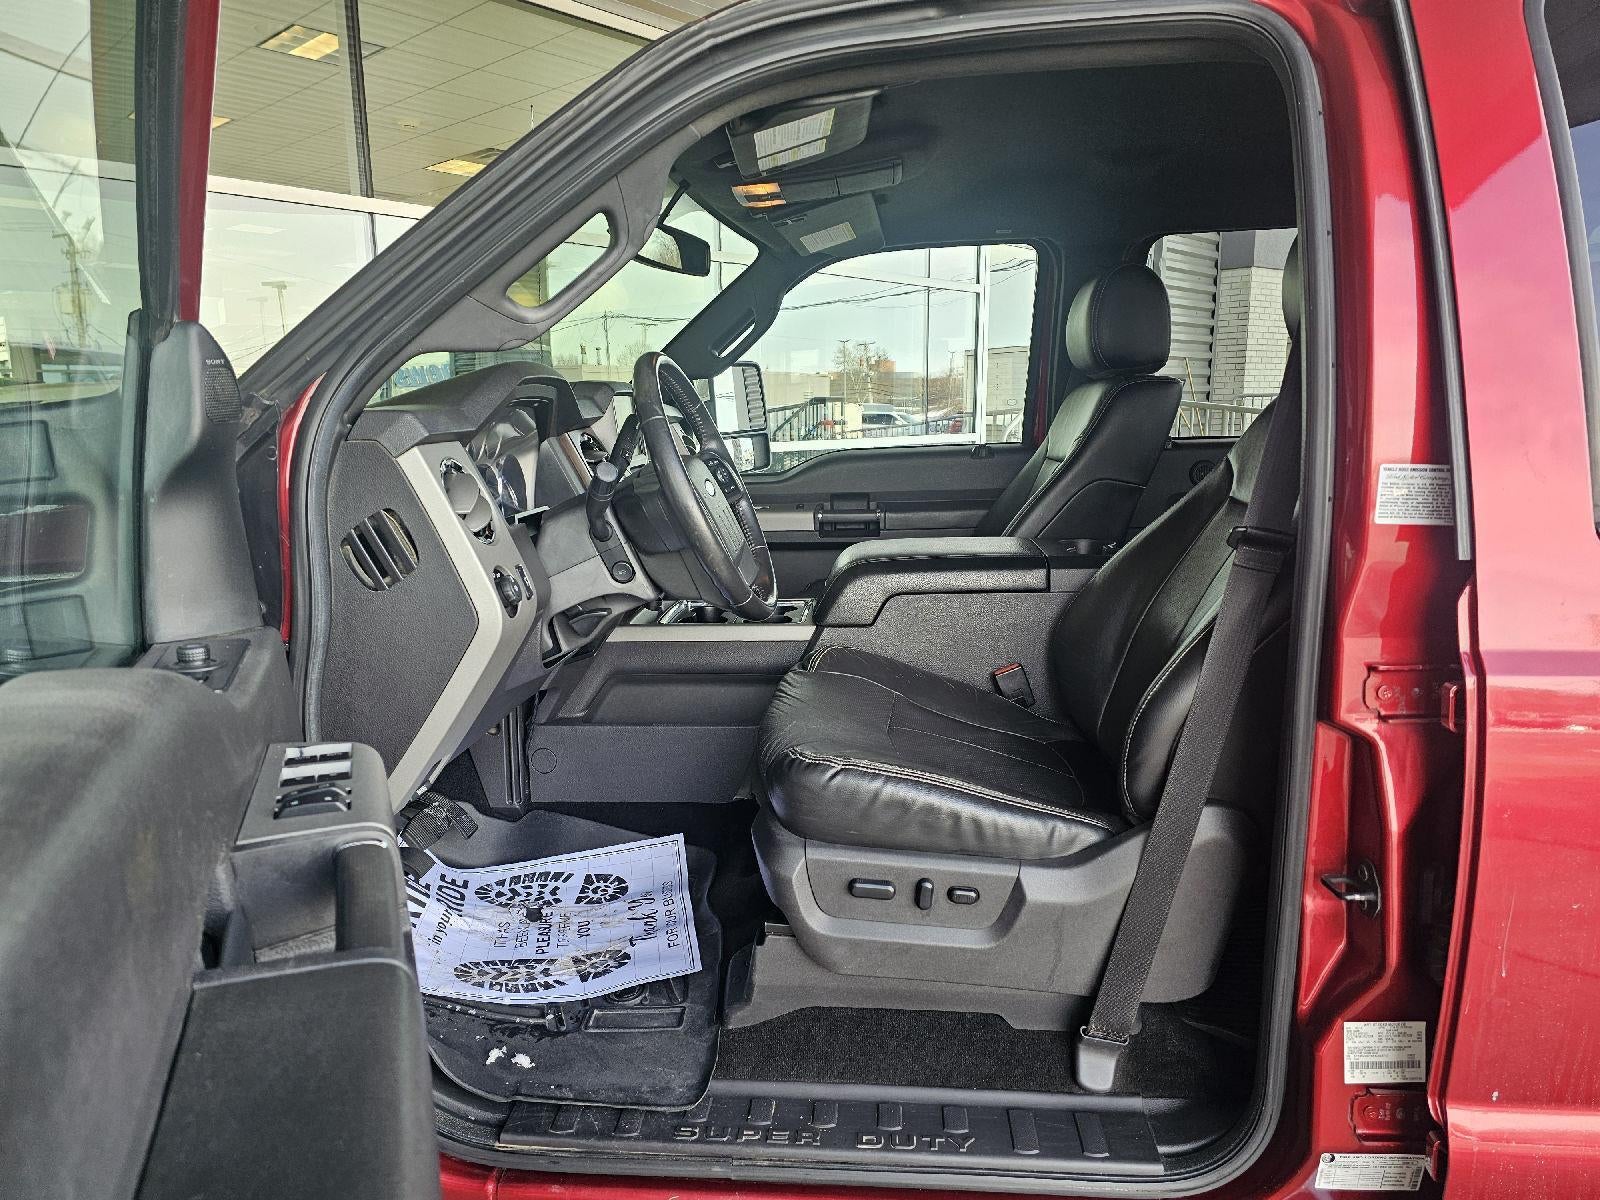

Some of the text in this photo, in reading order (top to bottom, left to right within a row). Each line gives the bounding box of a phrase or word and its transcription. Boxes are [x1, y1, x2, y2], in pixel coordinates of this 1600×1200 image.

[435, 908, 453, 937] your
[577, 920, 591, 938] YOU
[673, 1126, 976, 1152] SUPER DUTY
